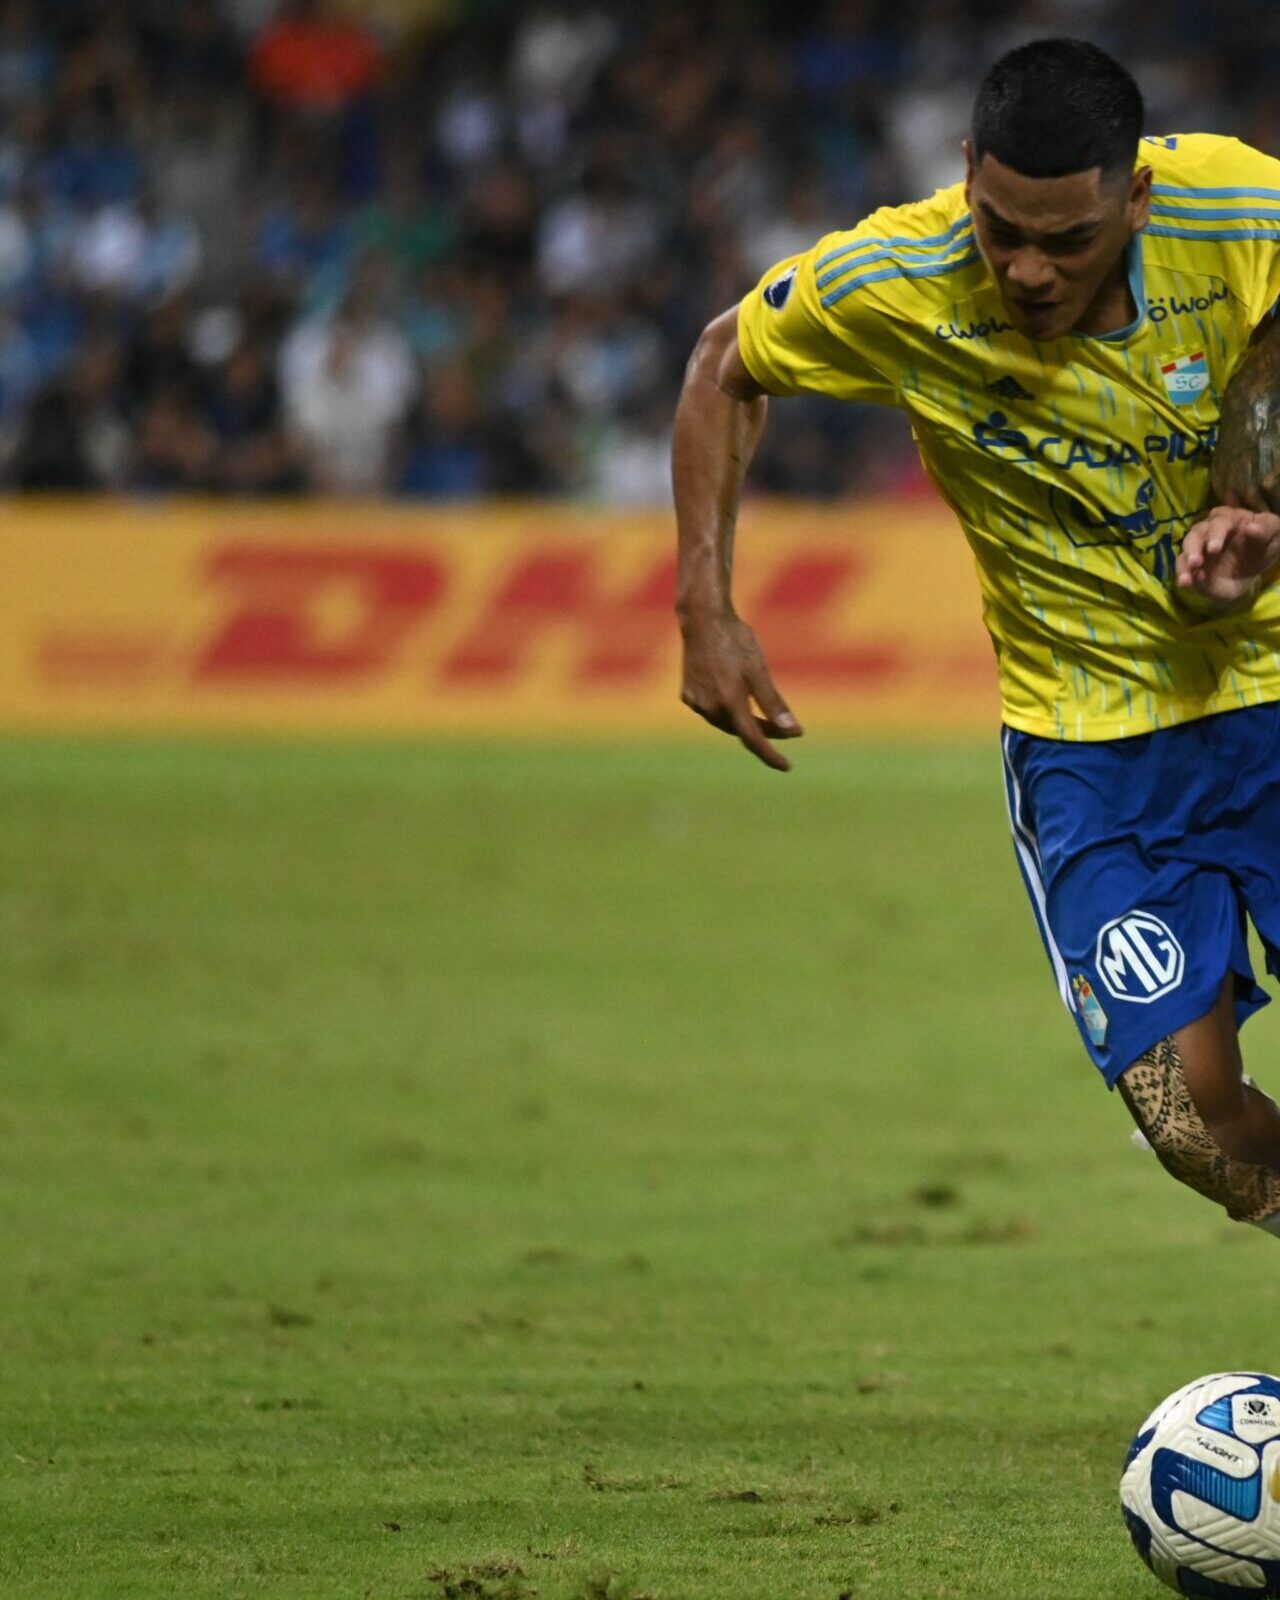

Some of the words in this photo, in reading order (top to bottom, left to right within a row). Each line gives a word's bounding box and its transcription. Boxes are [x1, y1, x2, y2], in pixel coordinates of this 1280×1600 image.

[1035, 437, 1141, 469] CAJA
[195, 545, 905, 688] DHL
[1103, 918, 1177, 993] MG
